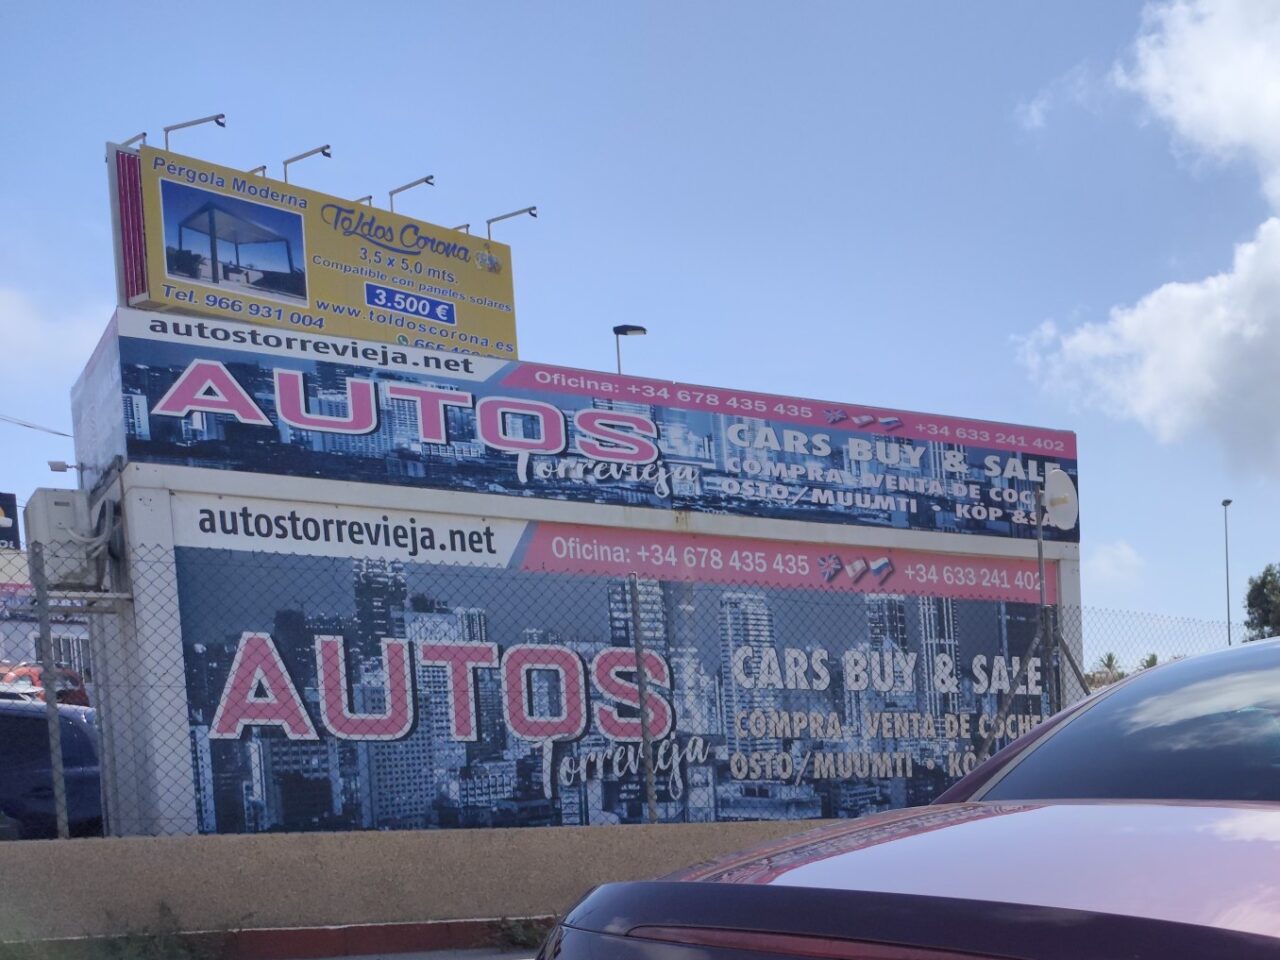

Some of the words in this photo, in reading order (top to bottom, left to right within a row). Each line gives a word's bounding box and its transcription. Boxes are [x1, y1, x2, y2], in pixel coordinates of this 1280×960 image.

[153, 156, 225, 188] Pérgola
[232, 177, 308, 209] Moderna
[321, 204, 395, 242] Toldos
[400, 223, 471, 263] Corona
[312, 255, 387, 280] Compatible
[391, 274, 414, 288] con
[418, 284, 465, 301] paneles
[469, 294, 512, 312] solares
[360, 247, 382, 265] 3,5
[427, 267, 458, 284] mts.
[162, 284, 198, 304] Tel.
[205, 294, 243, 312] 966
[249, 303, 283, 321] 931
[290, 312, 325, 329] 004
[316, 299, 514, 352] www.toldoscorona.es
[374, 289, 430, 315] 3.500
[435, 304, 449, 320] €
[149, 317, 475, 373] autostorrevieja.net
[151, 358, 659, 465] AUTOS
[534, 371, 619, 393] Oficina:
[627, 383, 670, 400] +34
[677, 389, 720, 407] 678
[726, 397, 768, 413] 435
[774, 403, 813, 419] 435
[915, 424, 950, 436] +34
[956, 427, 990, 442] 633
[995, 432, 1028, 447] 241
[1033, 439, 1065, 452] 402
[727, 423, 832, 457] CARS
[848, 437, 926, 468] BUY
[943, 450, 970, 475] &
[725, 457, 845, 484] COMPRA
[868, 473, 946, 496] VENTA
[953, 483, 981, 499] DE
[199, 506, 497, 556] autostorrevieja.net
[955, 501, 1003, 521] KÖP
[552, 536, 630, 563] Oficina:
[637, 544, 677, 566] +34
[683, 547, 723, 570] 678
[729, 550, 767, 574] 435
[773, 553, 809, 576] 435
[905, 563, 938, 584] +34
[943, 566, 976, 586] 633
[980, 568, 1010, 588] 241
[208, 631, 672, 742] AUTOS
[731, 645, 831, 691] CARS
[844, 649, 918, 693] BUY
[934, 652, 960, 694] &
[972, 654, 1043, 696] SALE
[735, 709, 842, 739] COMPRA
[864, 712, 937, 739] VENTA
[945, 713, 971, 739] DE
[979, 713, 1050, 740] COCH
[531, 731, 711, 800] Torreveja
[948, 744, 991, 778] KÖ
